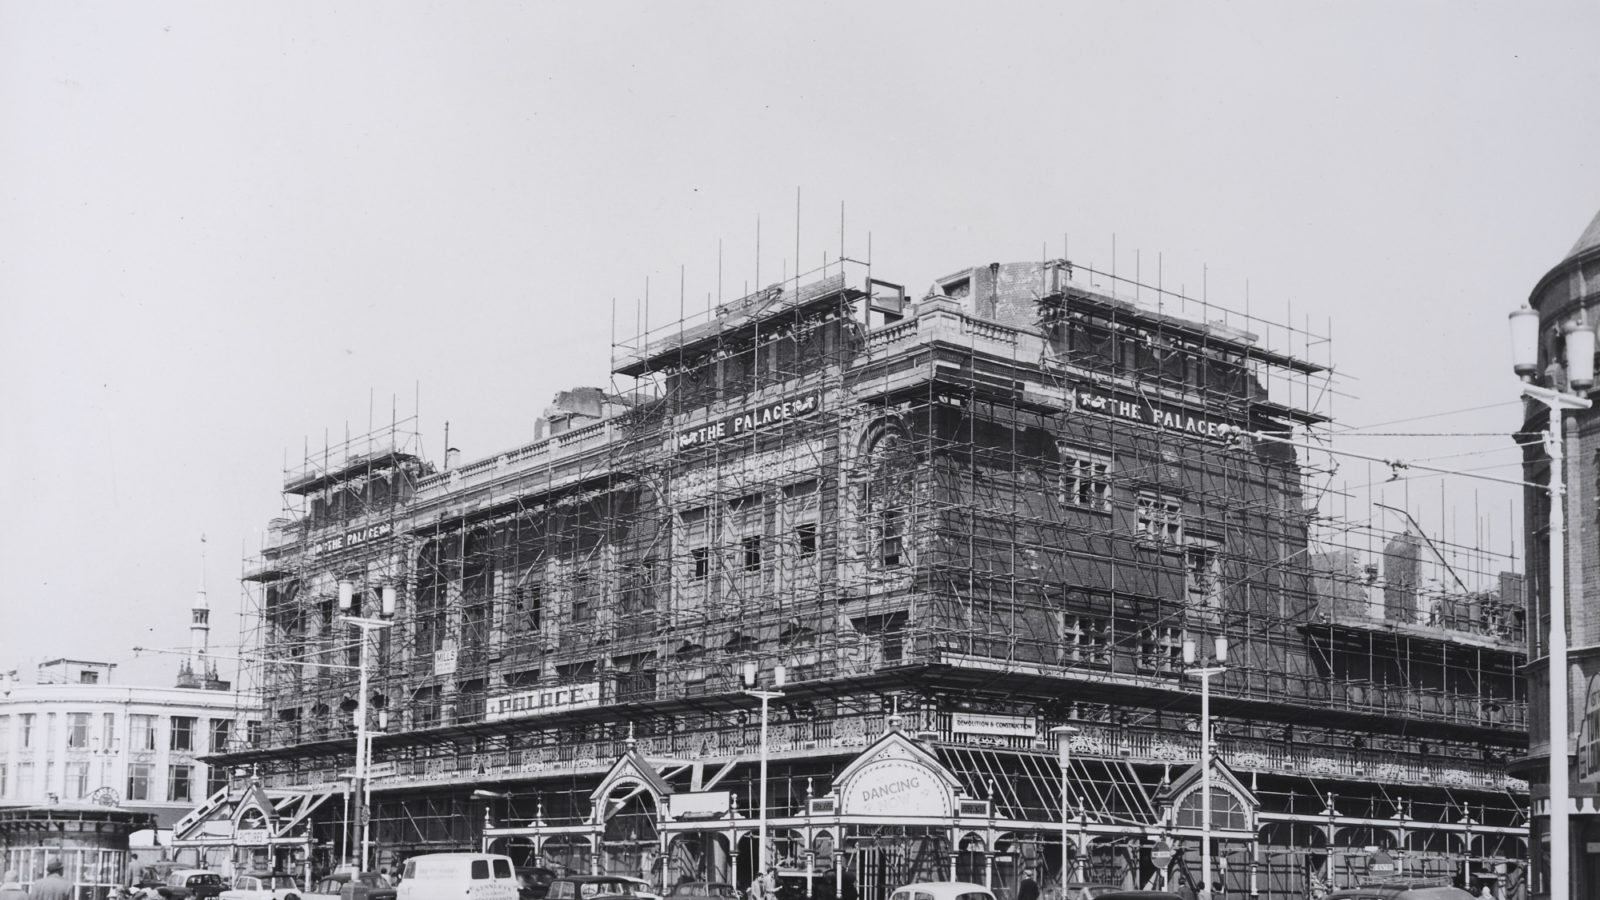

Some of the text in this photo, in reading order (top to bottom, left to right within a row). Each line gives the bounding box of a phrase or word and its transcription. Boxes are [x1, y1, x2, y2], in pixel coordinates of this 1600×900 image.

[698, 401, 792, 443] THE PALACE
[1107, 397, 1219, 437] THE PALACE
[956, 719, 989, 727] DEMOLITION
[862, 776, 920, 802] DANCING
